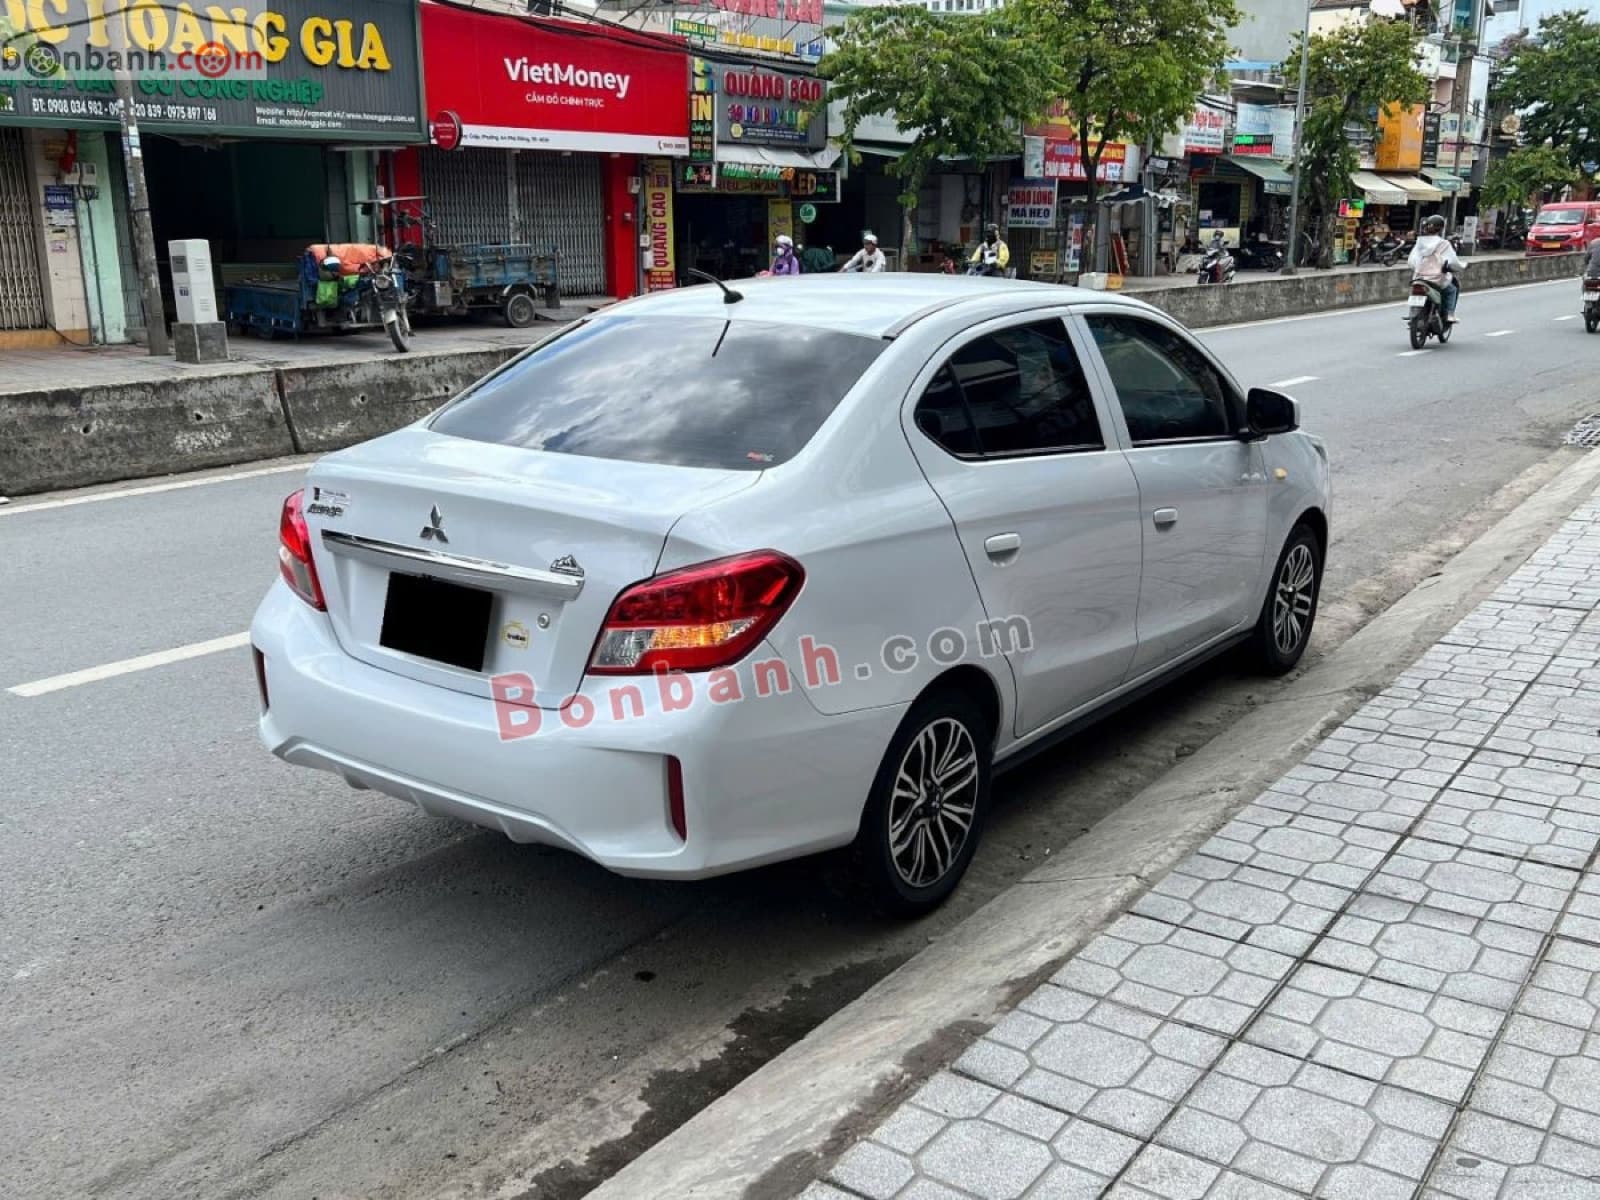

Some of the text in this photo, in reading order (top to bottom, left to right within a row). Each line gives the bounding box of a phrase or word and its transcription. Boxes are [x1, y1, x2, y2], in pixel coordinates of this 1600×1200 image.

[301, 17, 391, 72] GIA
[503, 57, 631, 99] VietMoney
[70, 99, 86, 113] 034
